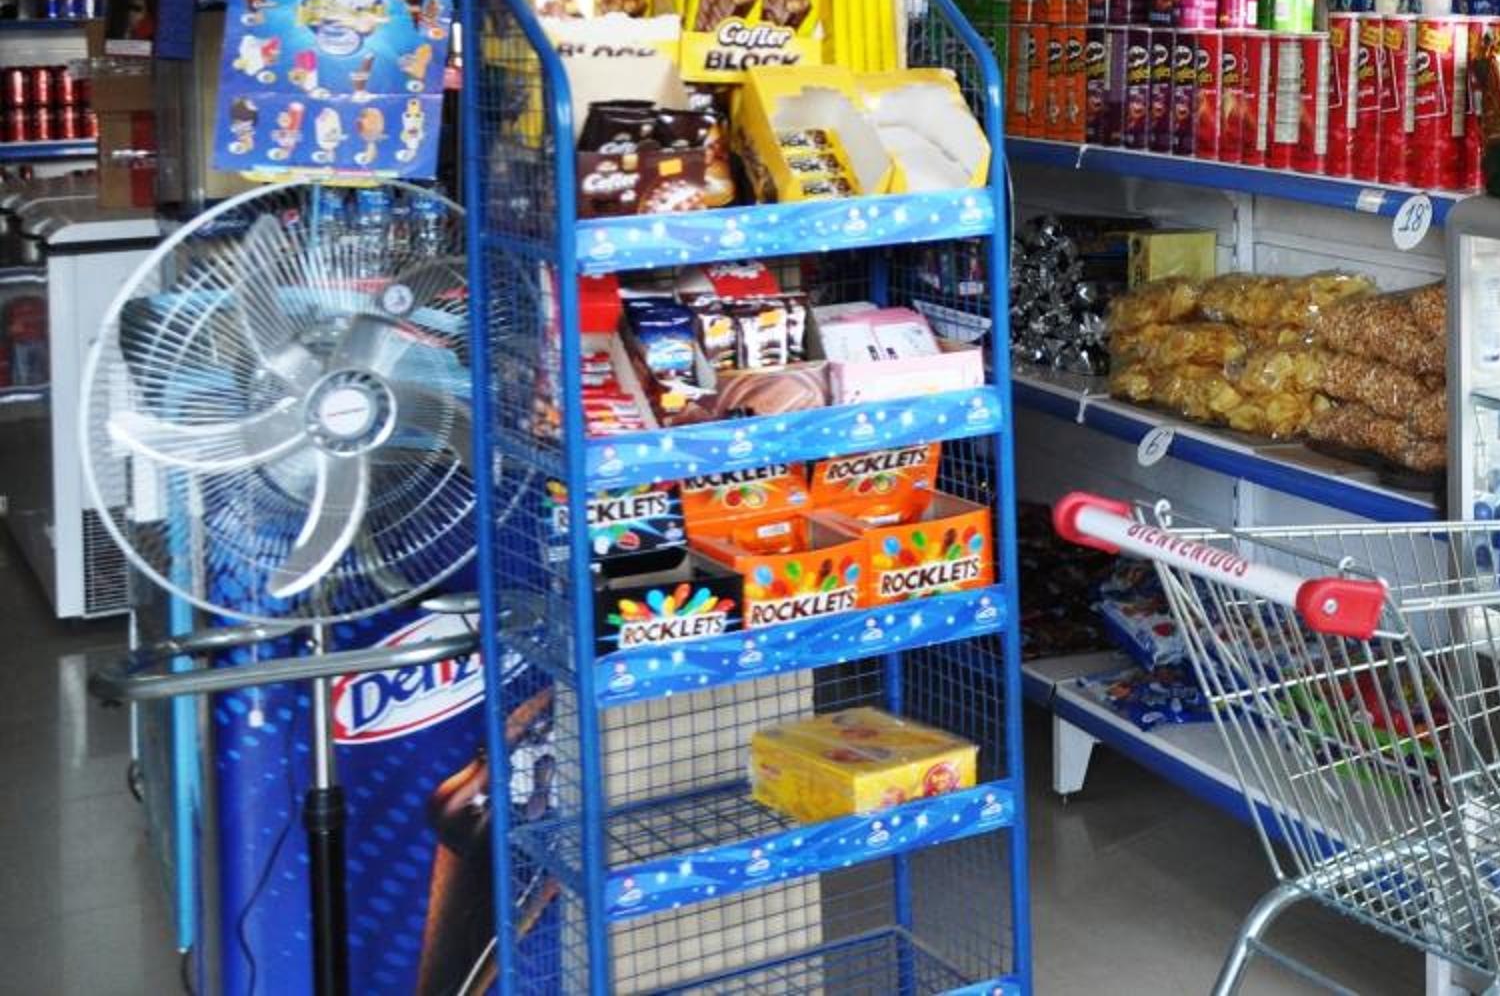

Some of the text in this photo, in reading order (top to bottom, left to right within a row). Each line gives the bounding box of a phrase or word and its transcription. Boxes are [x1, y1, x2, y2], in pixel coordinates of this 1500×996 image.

[827, 448, 928, 480] ROCKLETS
[880, 558, 980, 595] ROCKLETS
[749, 587, 858, 625] ROCKLETS
[622, 614, 725, 645] ROCKLETS
